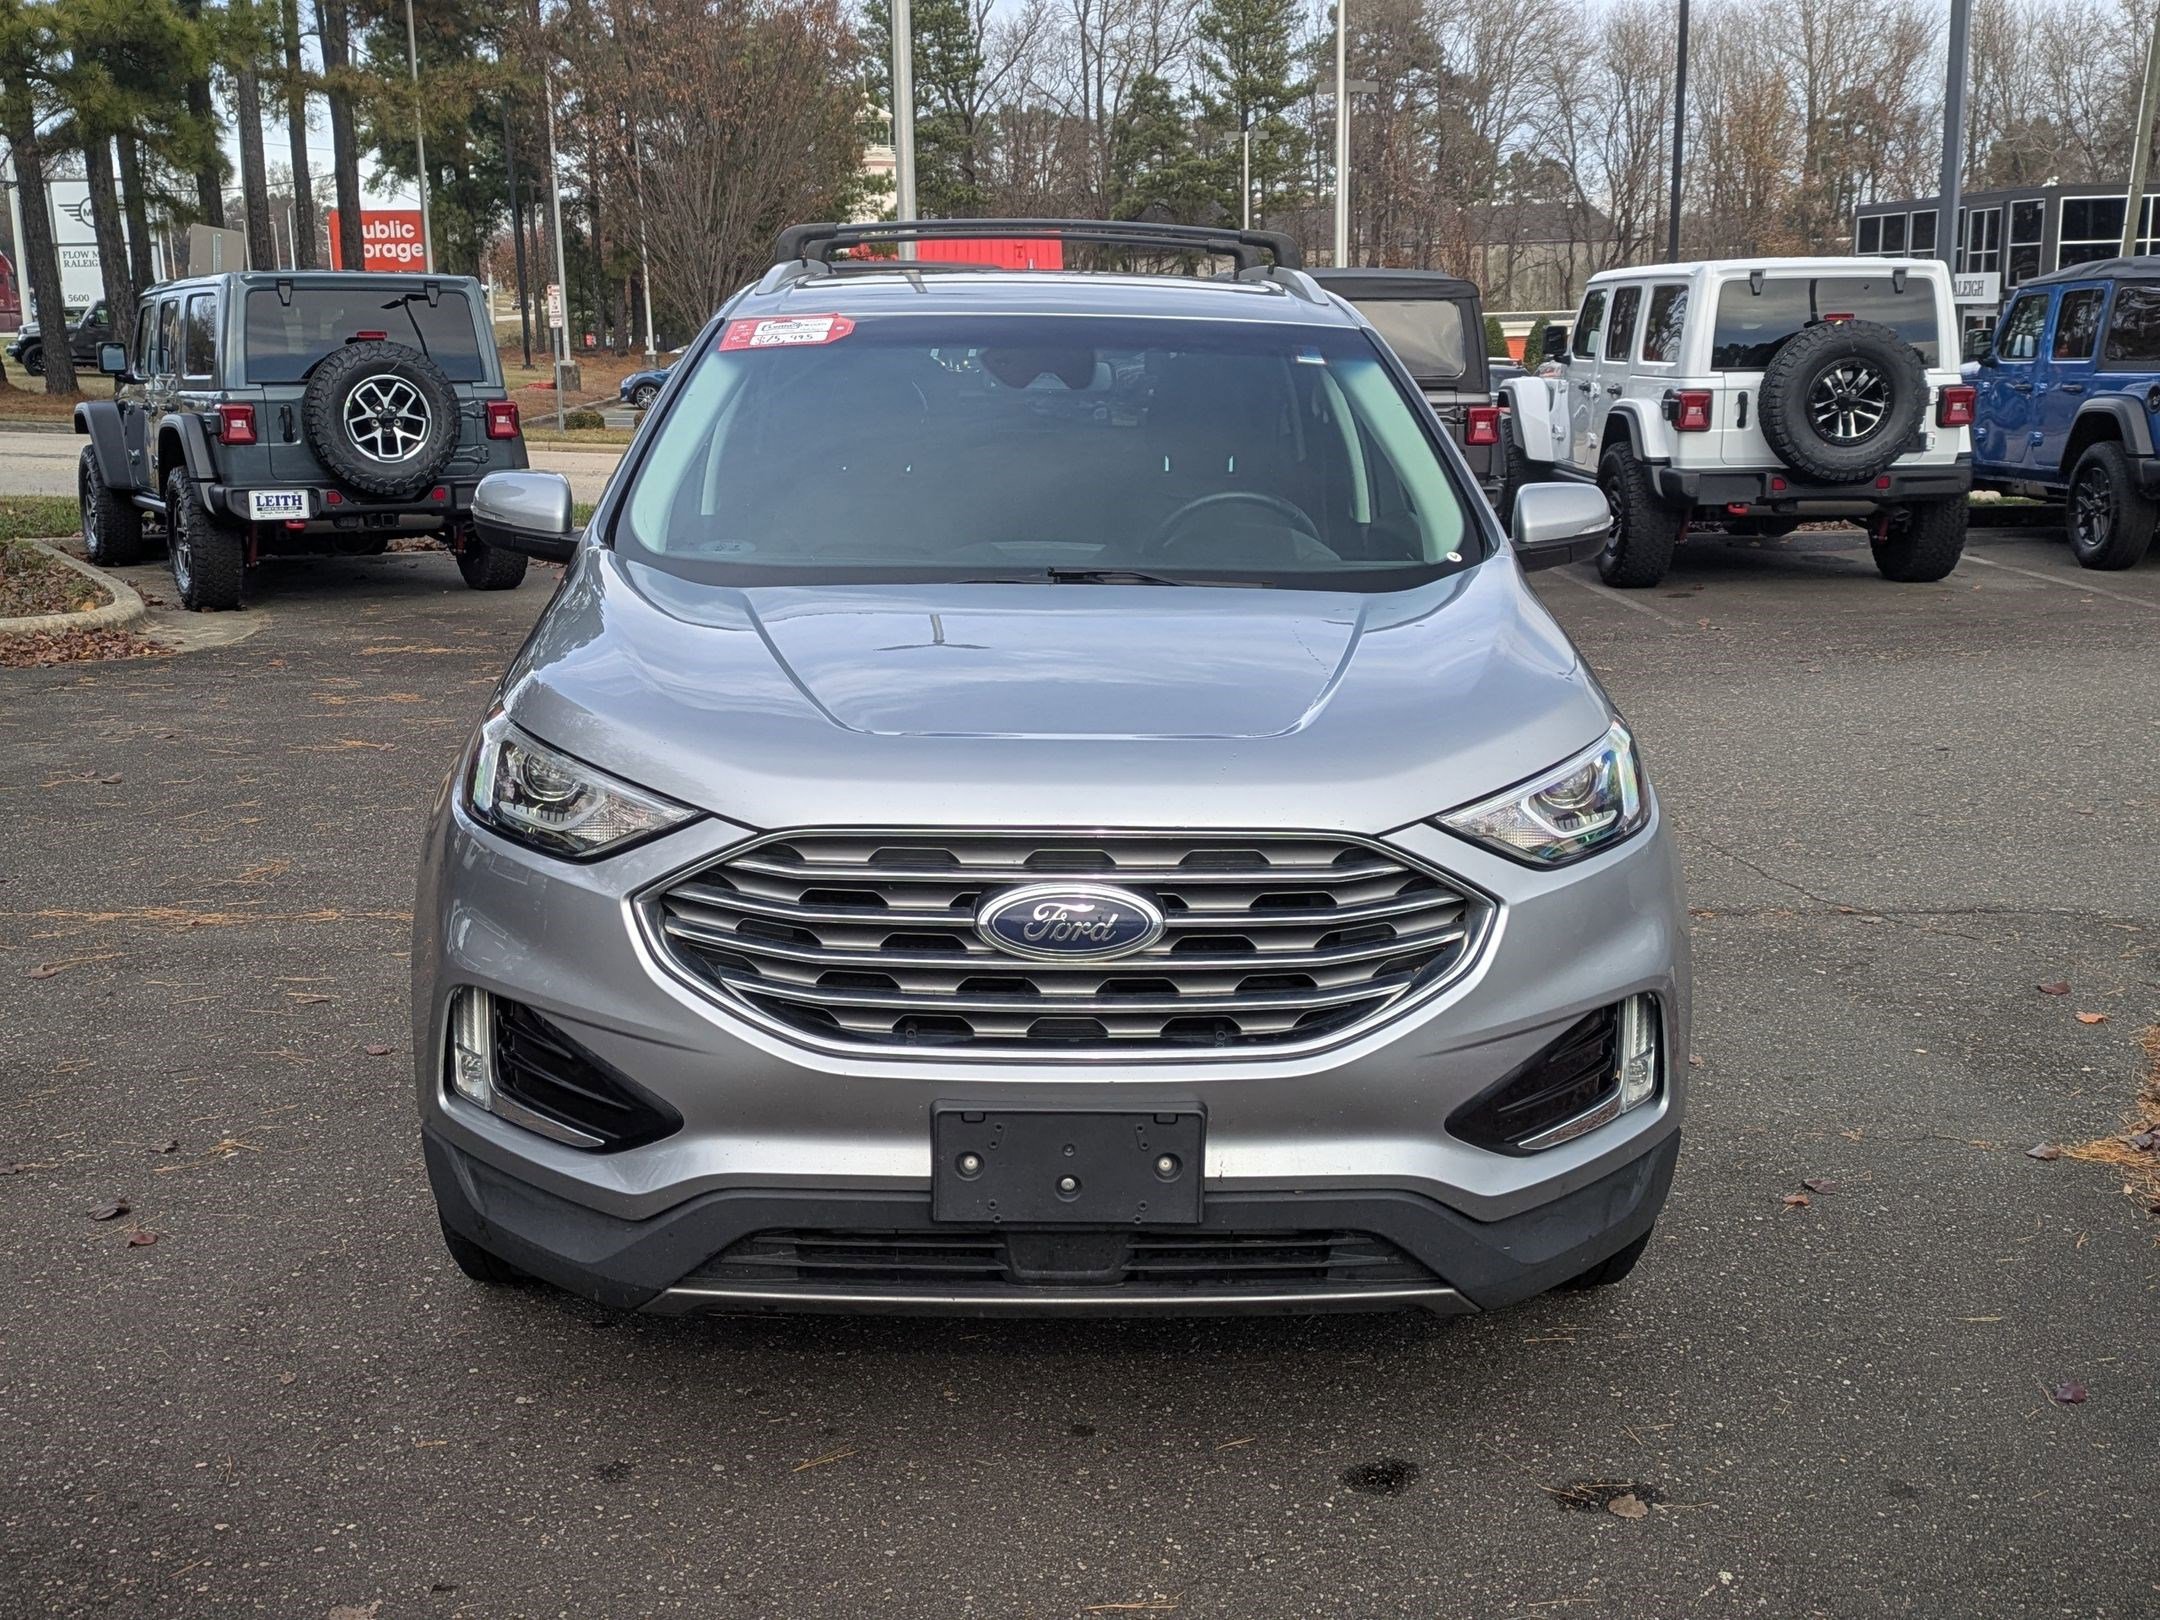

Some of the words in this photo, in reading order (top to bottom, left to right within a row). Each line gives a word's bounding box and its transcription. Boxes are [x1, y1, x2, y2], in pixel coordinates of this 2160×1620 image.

[362, 220, 415, 239] ublic
[62, 250, 89, 259] FLOW
[364, 242, 424, 263] orage
[63, 259, 99, 268] RALEIG
[1952, 280, 1984, 296] ALEIGH
[68, 294, 90, 302] 5600
[255, 495, 302, 507] LEITH
[1024, 902, 1119, 942] Ford
